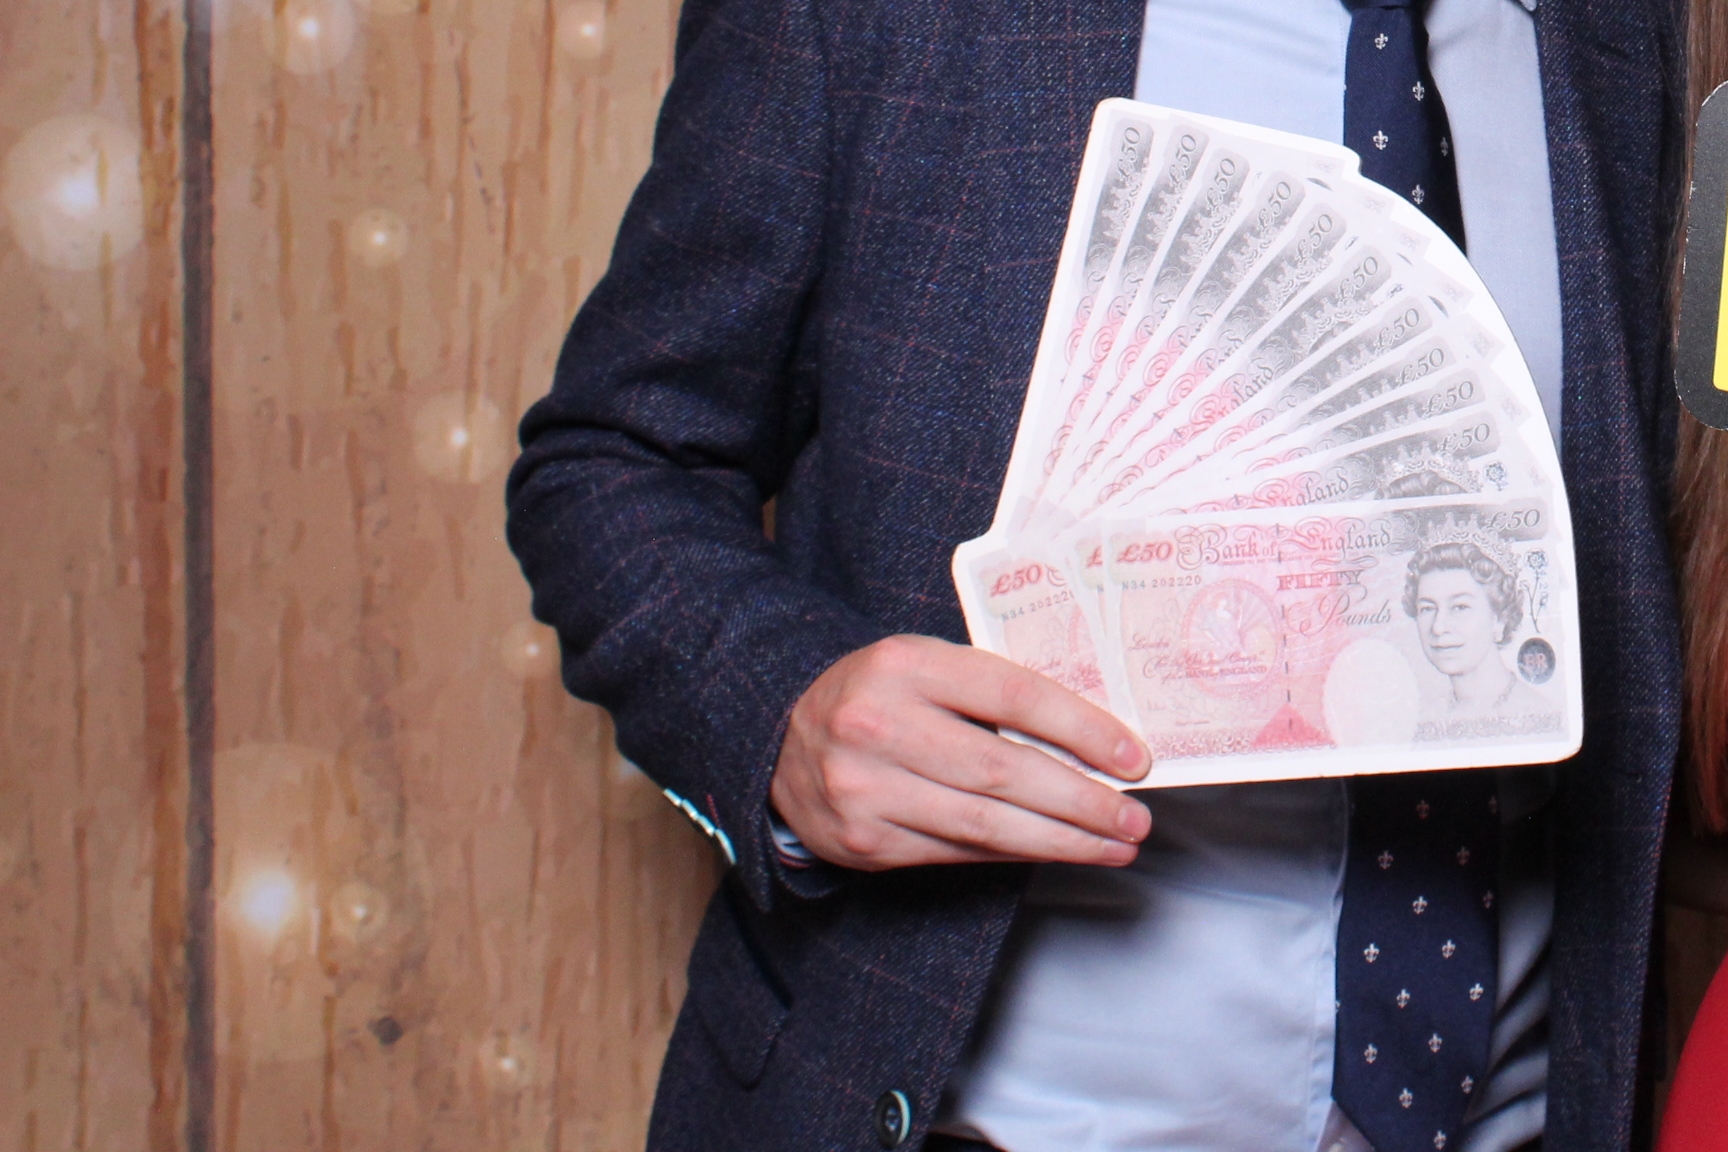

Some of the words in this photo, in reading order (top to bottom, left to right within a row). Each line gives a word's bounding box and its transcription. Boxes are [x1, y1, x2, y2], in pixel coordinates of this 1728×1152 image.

[1117, 127, 1141, 181] £50
[1169, 134, 1197, 186] £50
[1206, 157, 1236, 209] £50
[1257, 181, 1292, 231] £50
[1297, 213, 1333, 262] £50
[1337, 256, 1379, 299] £50
[1374, 308, 1420, 350] £50
[1396, 348, 1445, 387] £50
[1423, 381, 1475, 415] £50
[1437, 423, 1491, 453] £50
[1485, 509, 1541, 530] £50
[1116, 540, 1173, 563] £50
[1175, 523, 1259, 570] Bank
[1279, 517, 1392, 568] England
[990, 564, 1043, 597] £50
[1277, 569, 1363, 591] FIFTY
